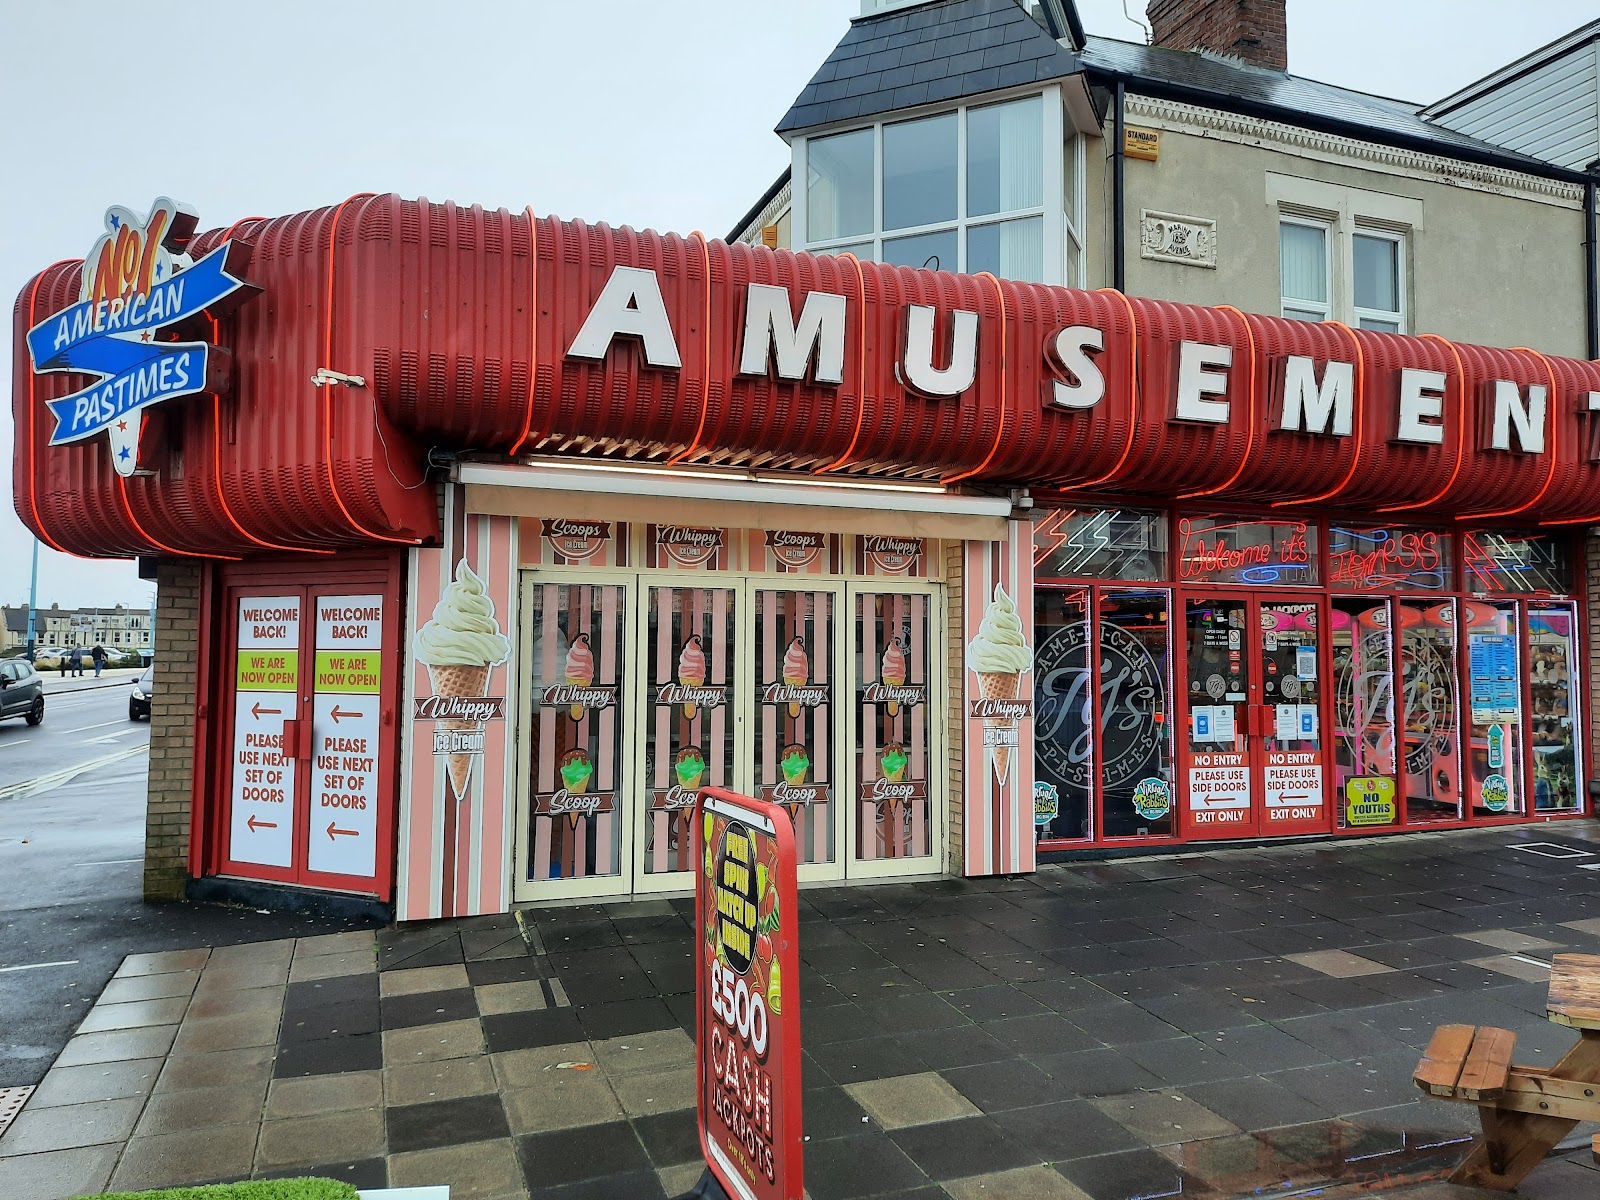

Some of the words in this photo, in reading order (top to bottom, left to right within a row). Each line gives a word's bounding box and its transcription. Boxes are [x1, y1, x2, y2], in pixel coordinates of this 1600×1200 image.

[1127, 131, 1157, 142] STANDARD
[1168, 224, 1192, 237] MARINE
[1168, 244, 1191, 254] AVENUE
[53, 278, 186, 351] AMERICAN
[566, 265, 1600, 460] AMUSEMEN
[71, 353, 191, 431] PASTIMES
[551, 517, 601, 541] Scoops
[661, 526, 718, 548] Whippy
[564, 539, 573, 549] Ice
[573, 539, 588, 550] Cream
[773, 530, 816, 550] Scoops
[869, 535, 918, 556] Whippy
[1179, 518, 1270, 578] Welcome
[679, 546, 687, 556] Ice
[687, 546, 701, 557] Cream
[792, 549, 806, 559] Cream
[890, 554, 903, 564] Cream
[243, 608, 298, 622] WELCOME
[321, 607, 380, 622] WELCOME
[253, 625, 286, 639] BACK!
[332, 625, 367, 639] BACK!
[251, 657, 264, 669] WE
[267, 657, 285, 669] ARE
[330, 658, 344, 670] WE
[347, 658, 367, 671] ARE
[241, 672, 265, 684] NOW
[268, 672, 295, 685] OPEN
[319, 673, 345, 686] NOW
[348, 674, 377, 686] OPEN
[543, 684, 613, 708] Whippy
[658, 683, 723, 707] Whippy
[764, 683, 825, 707] Whippy
[865, 683, 922, 705] Whippy
[420, 695, 498, 721] Whippy
[974, 698, 1028, 720] Whippy
[246, 733, 284, 749] PLEASE
[434, 733, 450, 751] Ice
[451, 731, 484, 752] Cream
[984, 728, 995, 745] Ice
[996, 728, 1019, 746] Cream
[324, 738, 367, 753] PLEASE
[239, 751, 260, 766] USE
[262, 753, 290, 767] NEXT
[317, 756, 339, 771] USE
[342, 757, 373, 772] NEXT
[1195, 755, 1210, 766] NO
[1214, 755, 1242, 766] ENTRY
[1270, 754, 1285, 764] NO
[1287, 754, 1315, 764] ENTRY
[245, 770, 264, 784] SET
[266, 770, 282, 785] OF
[1195, 771, 1225, 780] PLEASE
[1228, 771, 1244, 779] USE
[1270, 769, 1298, 779] PLEASE
[1301, 769, 1316, 778] USE
[324, 775, 344, 789] SET
[347, 776, 365, 790] OF
[872, 778, 915, 802] Scoop
[1192, 783, 1212, 792] SIDE
[1214, 782, 1247, 791] DOORS
[1267, 781, 1285, 790] SIDE
[1288, 780, 1319, 789] DOORS
[242, 787, 284, 803] DOORS
[321, 792, 367, 810] DOORS
[664, 785, 697, 809] Sco
[772, 781, 817, 806] Scoop
[1363, 793, 1379, 802] NO
[549, 789, 602, 816] Scoop
[1035, 798, 1056, 813] abbids
[1352, 804, 1390, 814] YOUTHS
[1196, 812, 1215, 823] EXIT
[1218, 811, 1244, 822] ONLY
[1270, 809, 1290, 820] EXIT
[1292, 808, 1316, 818] ONLY
[726, 831, 749, 864] FREE
[723, 860, 749, 896] SPINS
[717, 886, 744, 925] MATCH
[744, 900, 757, 932] UP
[722, 918, 750, 961] INSIDE
[711, 958, 767, 1055] £500
[711, 1025, 772, 1133] CASH
[712, 1082, 774, 1180] JACKPOTS
